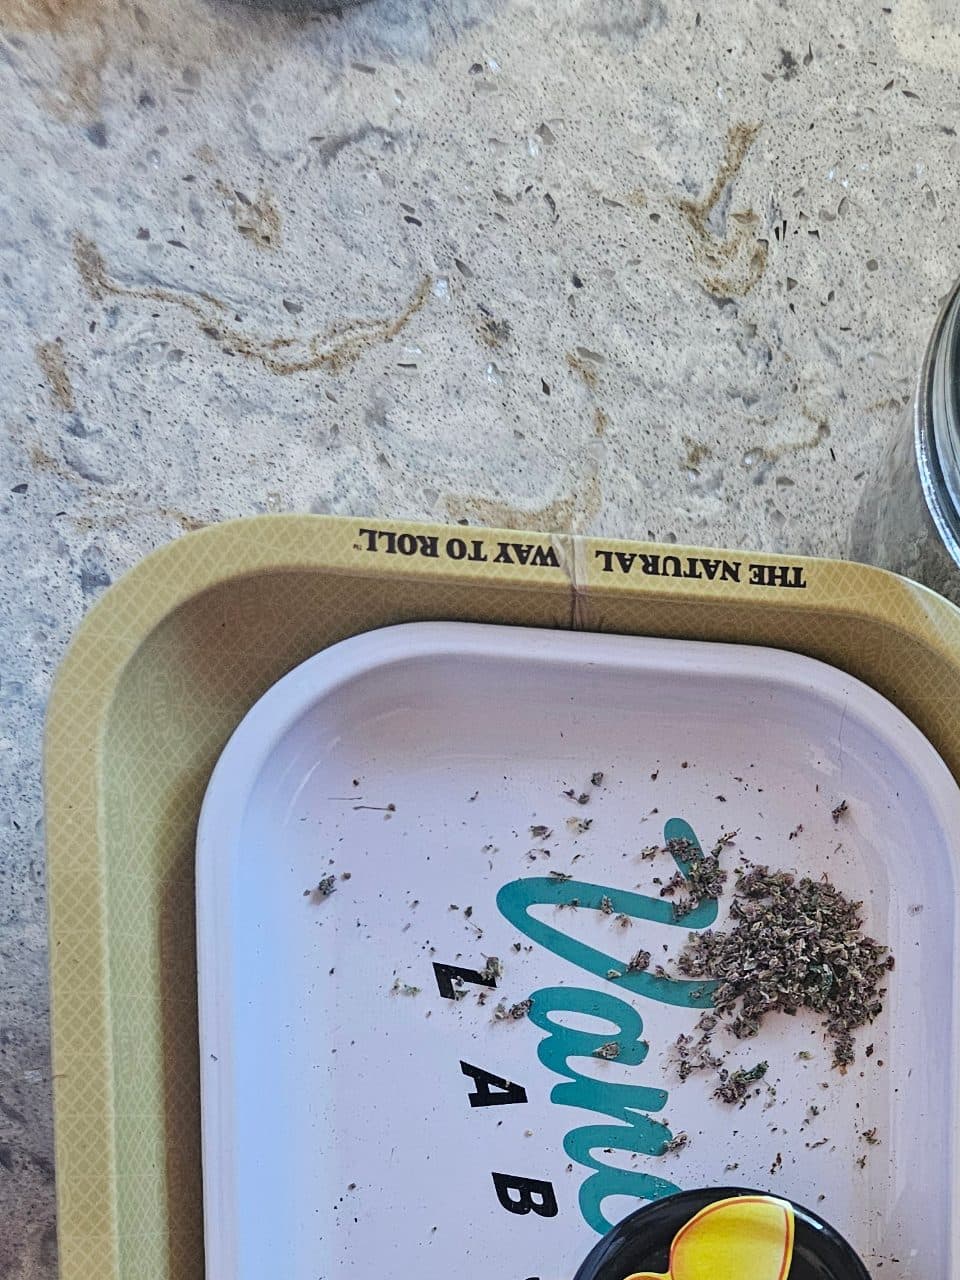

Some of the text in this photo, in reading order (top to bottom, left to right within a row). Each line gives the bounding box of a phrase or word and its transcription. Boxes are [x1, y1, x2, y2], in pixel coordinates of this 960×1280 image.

[446, 538, 488, 562] TO
[493, 543, 560, 568] WAY
[595, 550, 742, 584] NATURAL
[749, 563, 807, 589] THE
